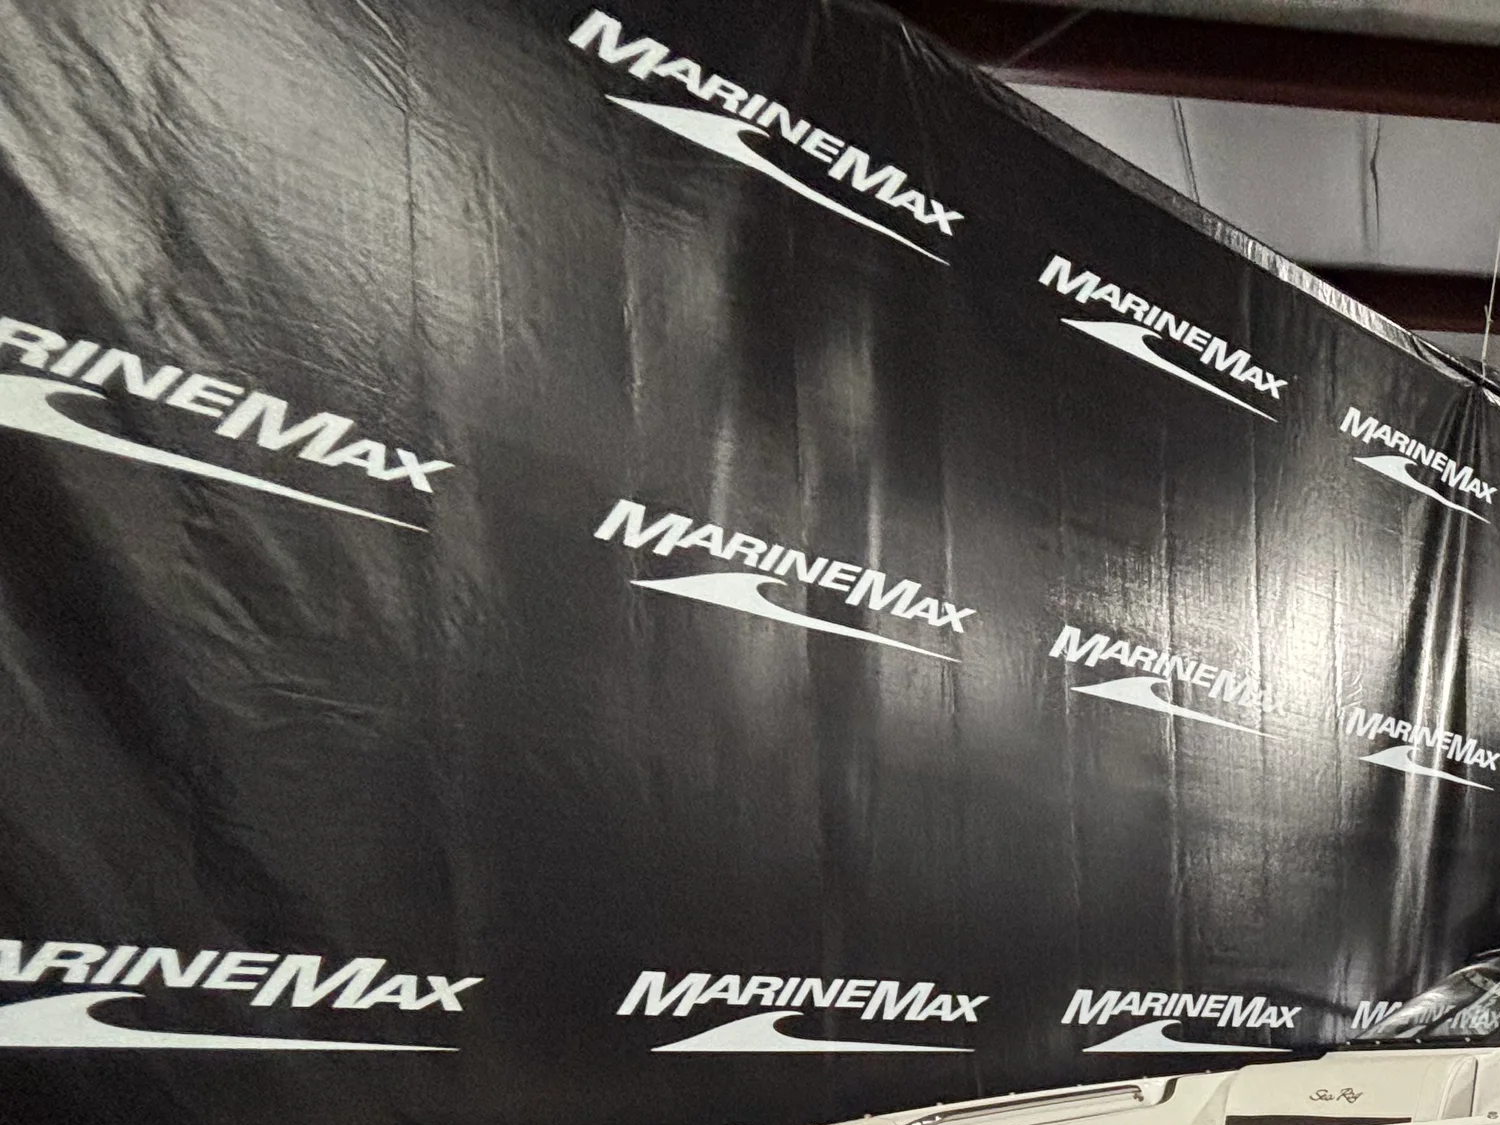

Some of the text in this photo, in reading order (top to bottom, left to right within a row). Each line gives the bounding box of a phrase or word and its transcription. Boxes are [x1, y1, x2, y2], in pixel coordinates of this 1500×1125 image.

[568, 9, 965, 236] MARINEMAX
[1038, 255, 1288, 400] MARINEMAX
[1339, 406, 1498, 505] MARINEMAX
[594, 498, 977, 634] MARINEMAX
[616, 970, 990, 1023] MARINEMAX
[1061, 988, 1302, 1030] MARINEMAX
